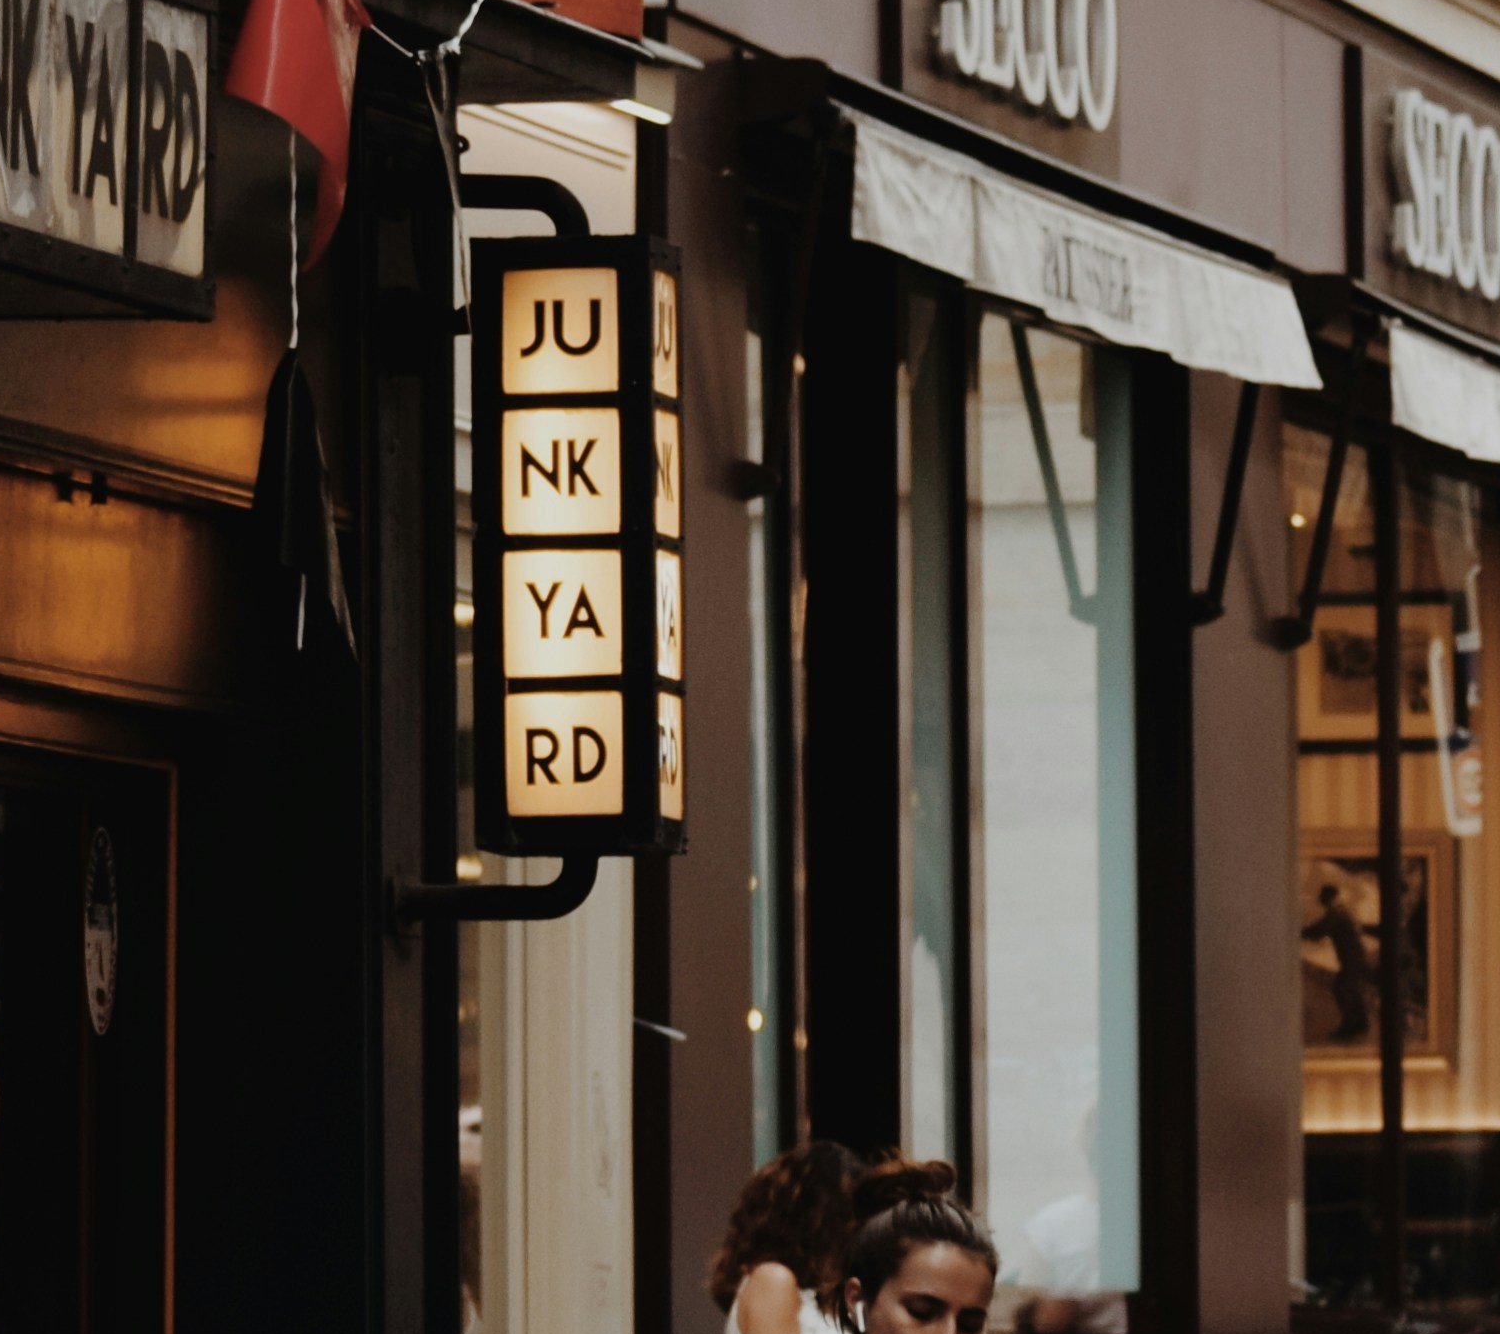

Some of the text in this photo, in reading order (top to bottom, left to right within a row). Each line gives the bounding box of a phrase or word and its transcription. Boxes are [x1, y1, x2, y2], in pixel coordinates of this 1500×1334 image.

[520, 298, 602, 358] JU
[520, 437, 601, 498] NK
[525, 581, 606, 639] YA
[526, 726, 607, 786] RD
